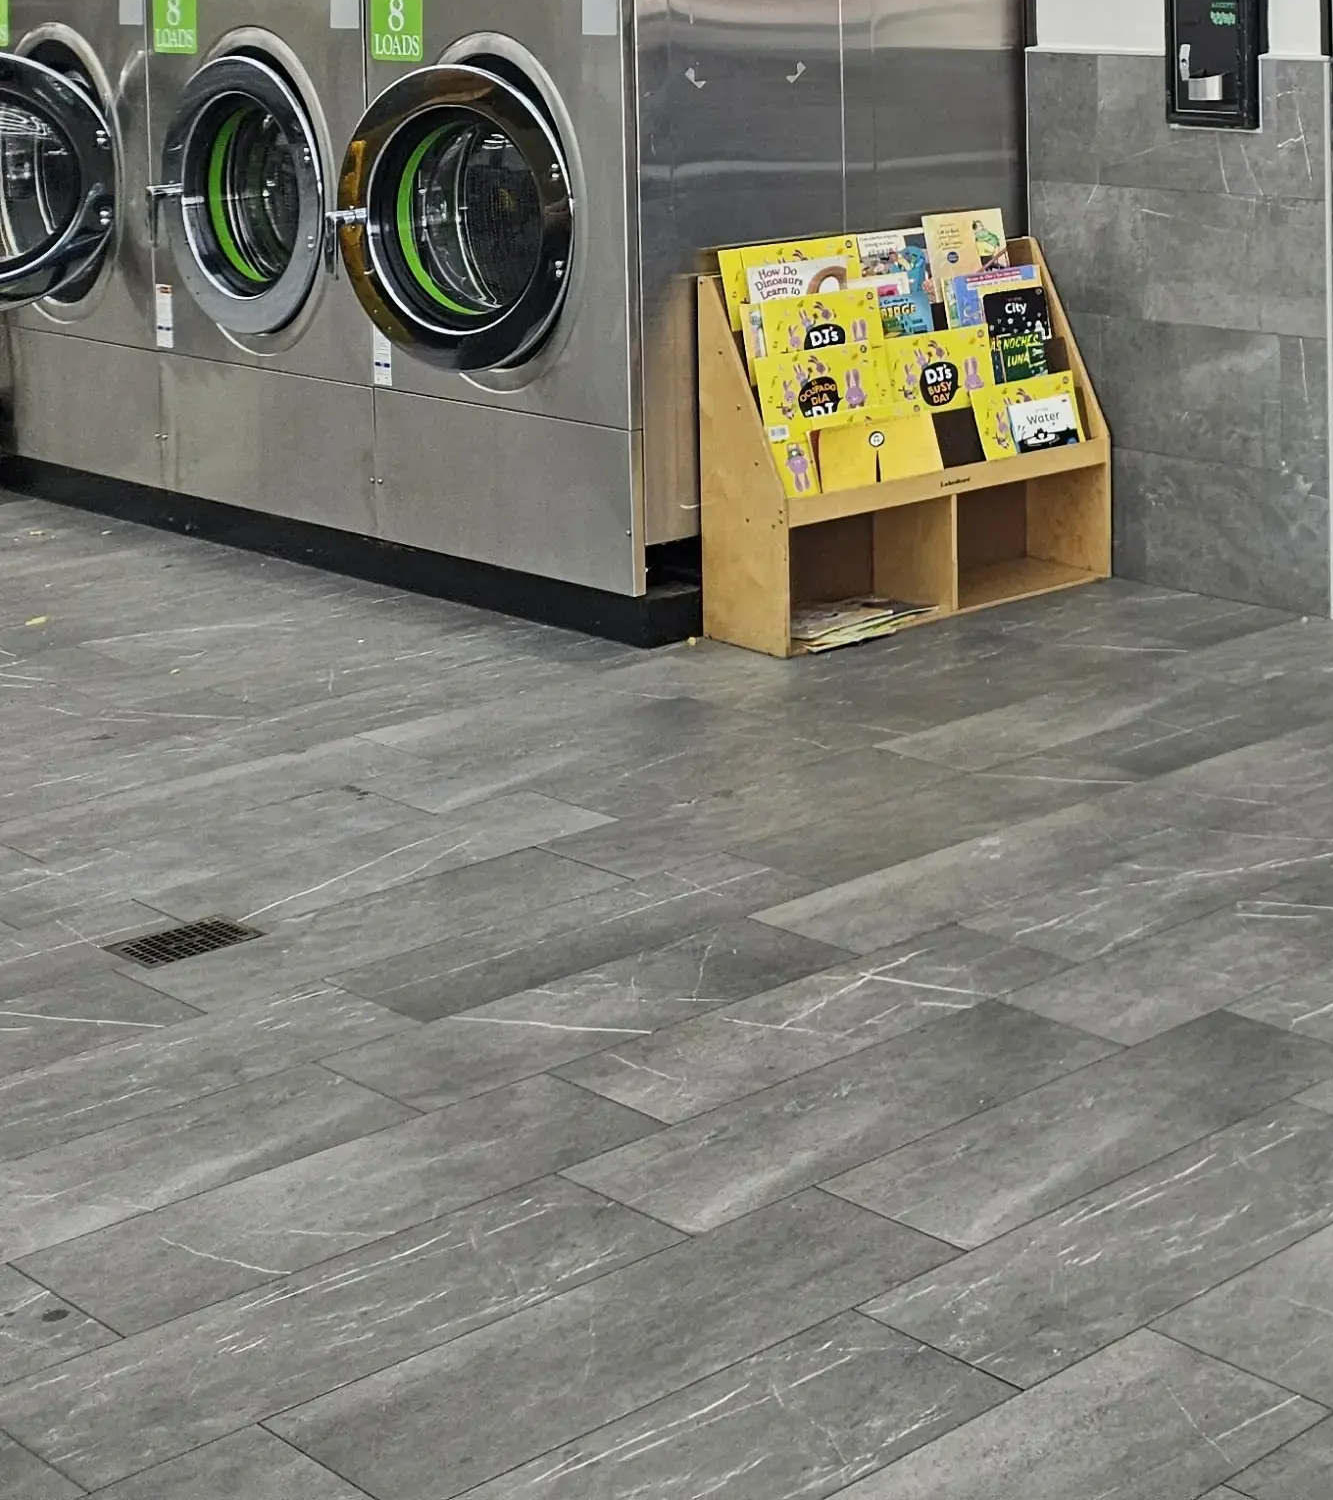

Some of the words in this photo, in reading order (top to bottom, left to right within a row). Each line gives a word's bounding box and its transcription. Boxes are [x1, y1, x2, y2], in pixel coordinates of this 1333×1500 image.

[155, 28, 196, 48] LOADS
[374, 33, 420, 57] LOADS
[758, 266, 781, 280] How
[783, 265, 797, 276] Do
[754, 276, 804, 292] Dinosaurs
[760, 286, 788, 300] Learn
[790, 287, 801, 297] to
[1004, 301, 1028, 316] City
[809, 326, 839, 347] DJ's
[1003, 333, 1040, 351] NOCHES
[1006, 351, 1031, 368] LUNA
[924, 363, 953, 385] DJ's
[800, 383, 837, 402] OCUPADO
[927, 380, 952, 396] BUSY
[811, 392, 831, 405] DÍA
[932, 392, 951, 405] DAY
[1026, 410, 1060, 426] Water
